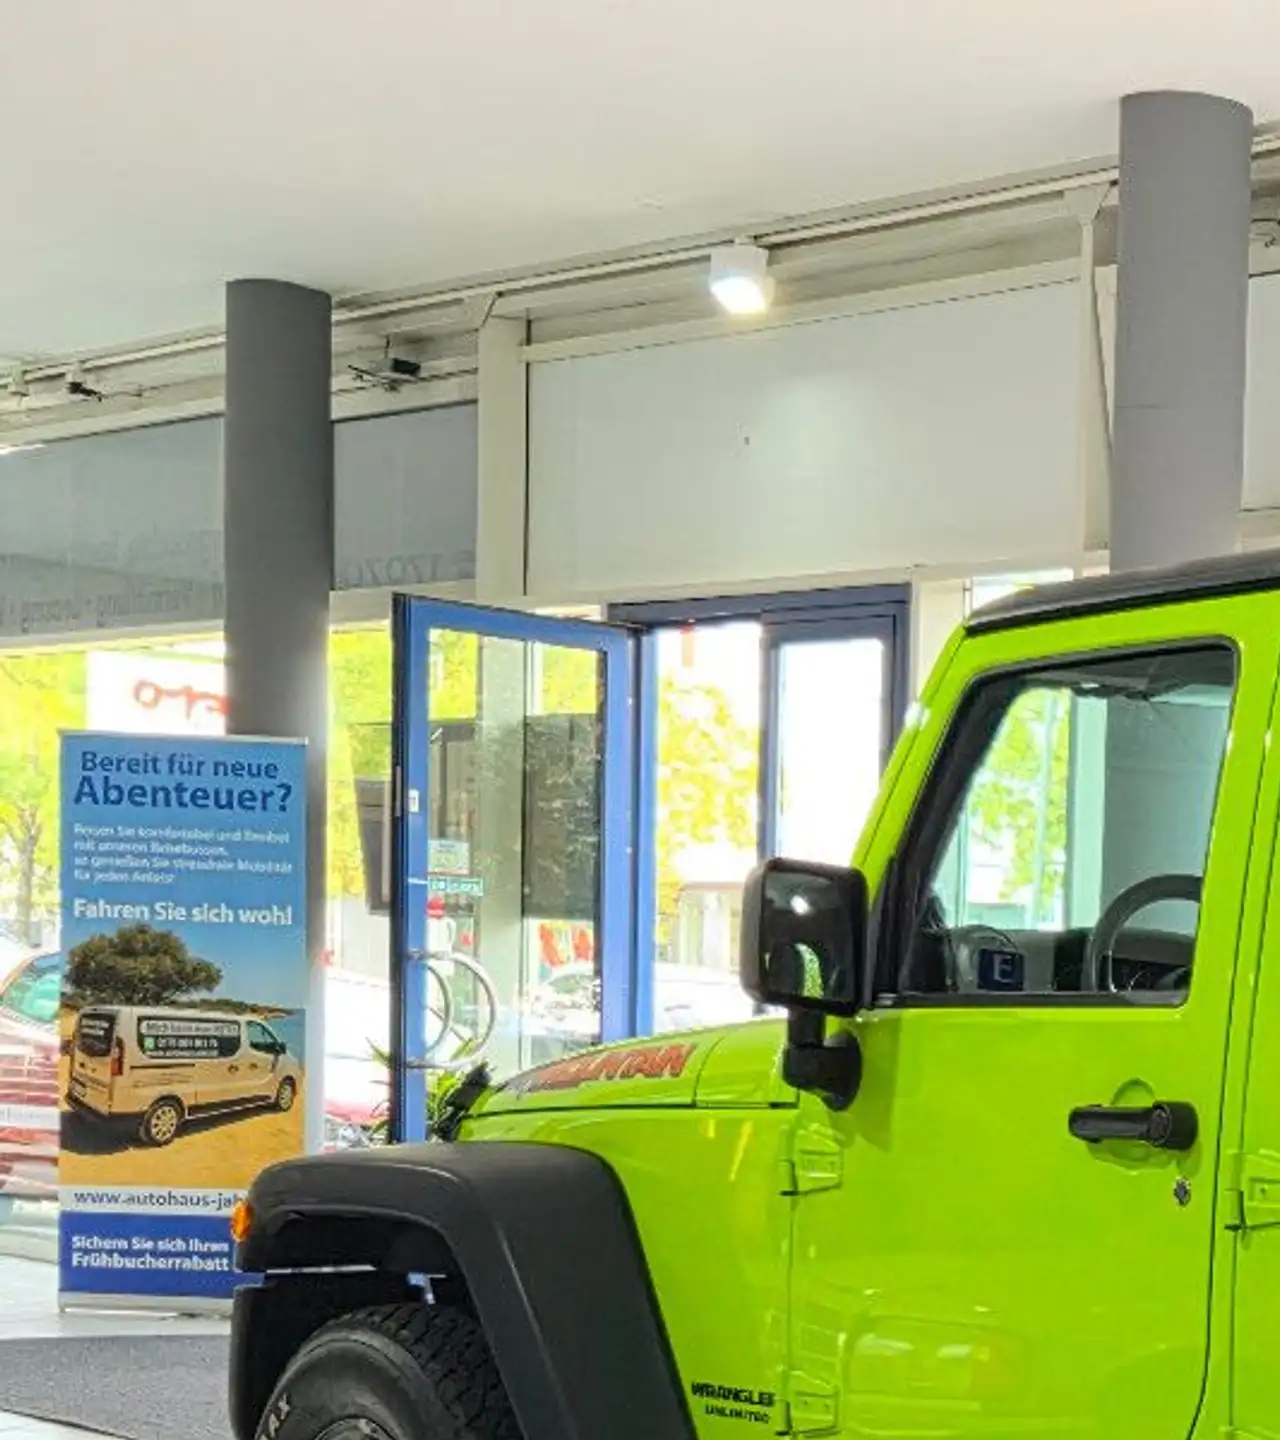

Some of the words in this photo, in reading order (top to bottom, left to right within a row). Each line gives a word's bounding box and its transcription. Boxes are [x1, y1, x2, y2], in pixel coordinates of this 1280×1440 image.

[81, 751, 162, 775] Bereit
[168, 753, 208, 777] für
[214, 761, 279, 778] neue
[73, 776, 293, 813] Abenteuer?
[74, 898, 149, 919] Fahren
[154, 900, 187, 922] Sie
[191, 903, 233, 924] sich
[237, 904, 292, 926] wohl
[72, 1236, 128, 1250] Sichern
[132, 1237, 154, 1250] Sie
[157, 1238, 186, 1251] sich
[189, 1238, 229, 1253] Ihren
[72, 1252, 229, 1272] Frühbucherrabatt
